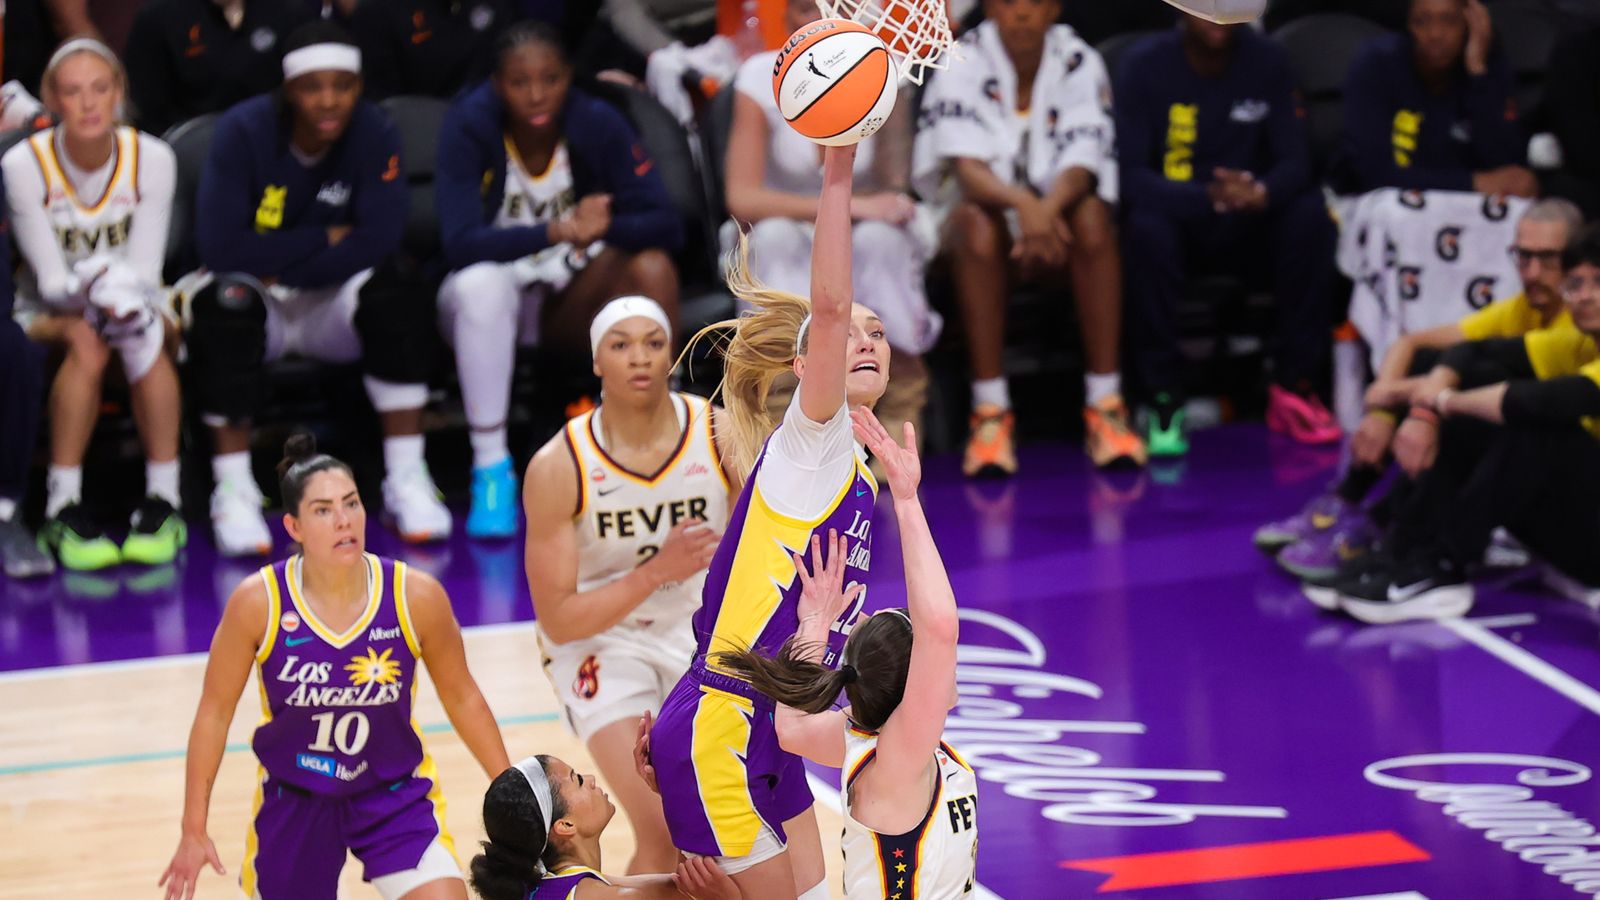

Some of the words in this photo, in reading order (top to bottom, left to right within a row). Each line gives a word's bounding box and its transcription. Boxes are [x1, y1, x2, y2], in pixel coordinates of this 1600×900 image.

[596, 496, 708, 538] FEVER
[368, 626, 400, 642] Albert
[308, 711, 371, 756] 10
[301, 755, 330, 774] UCLA
